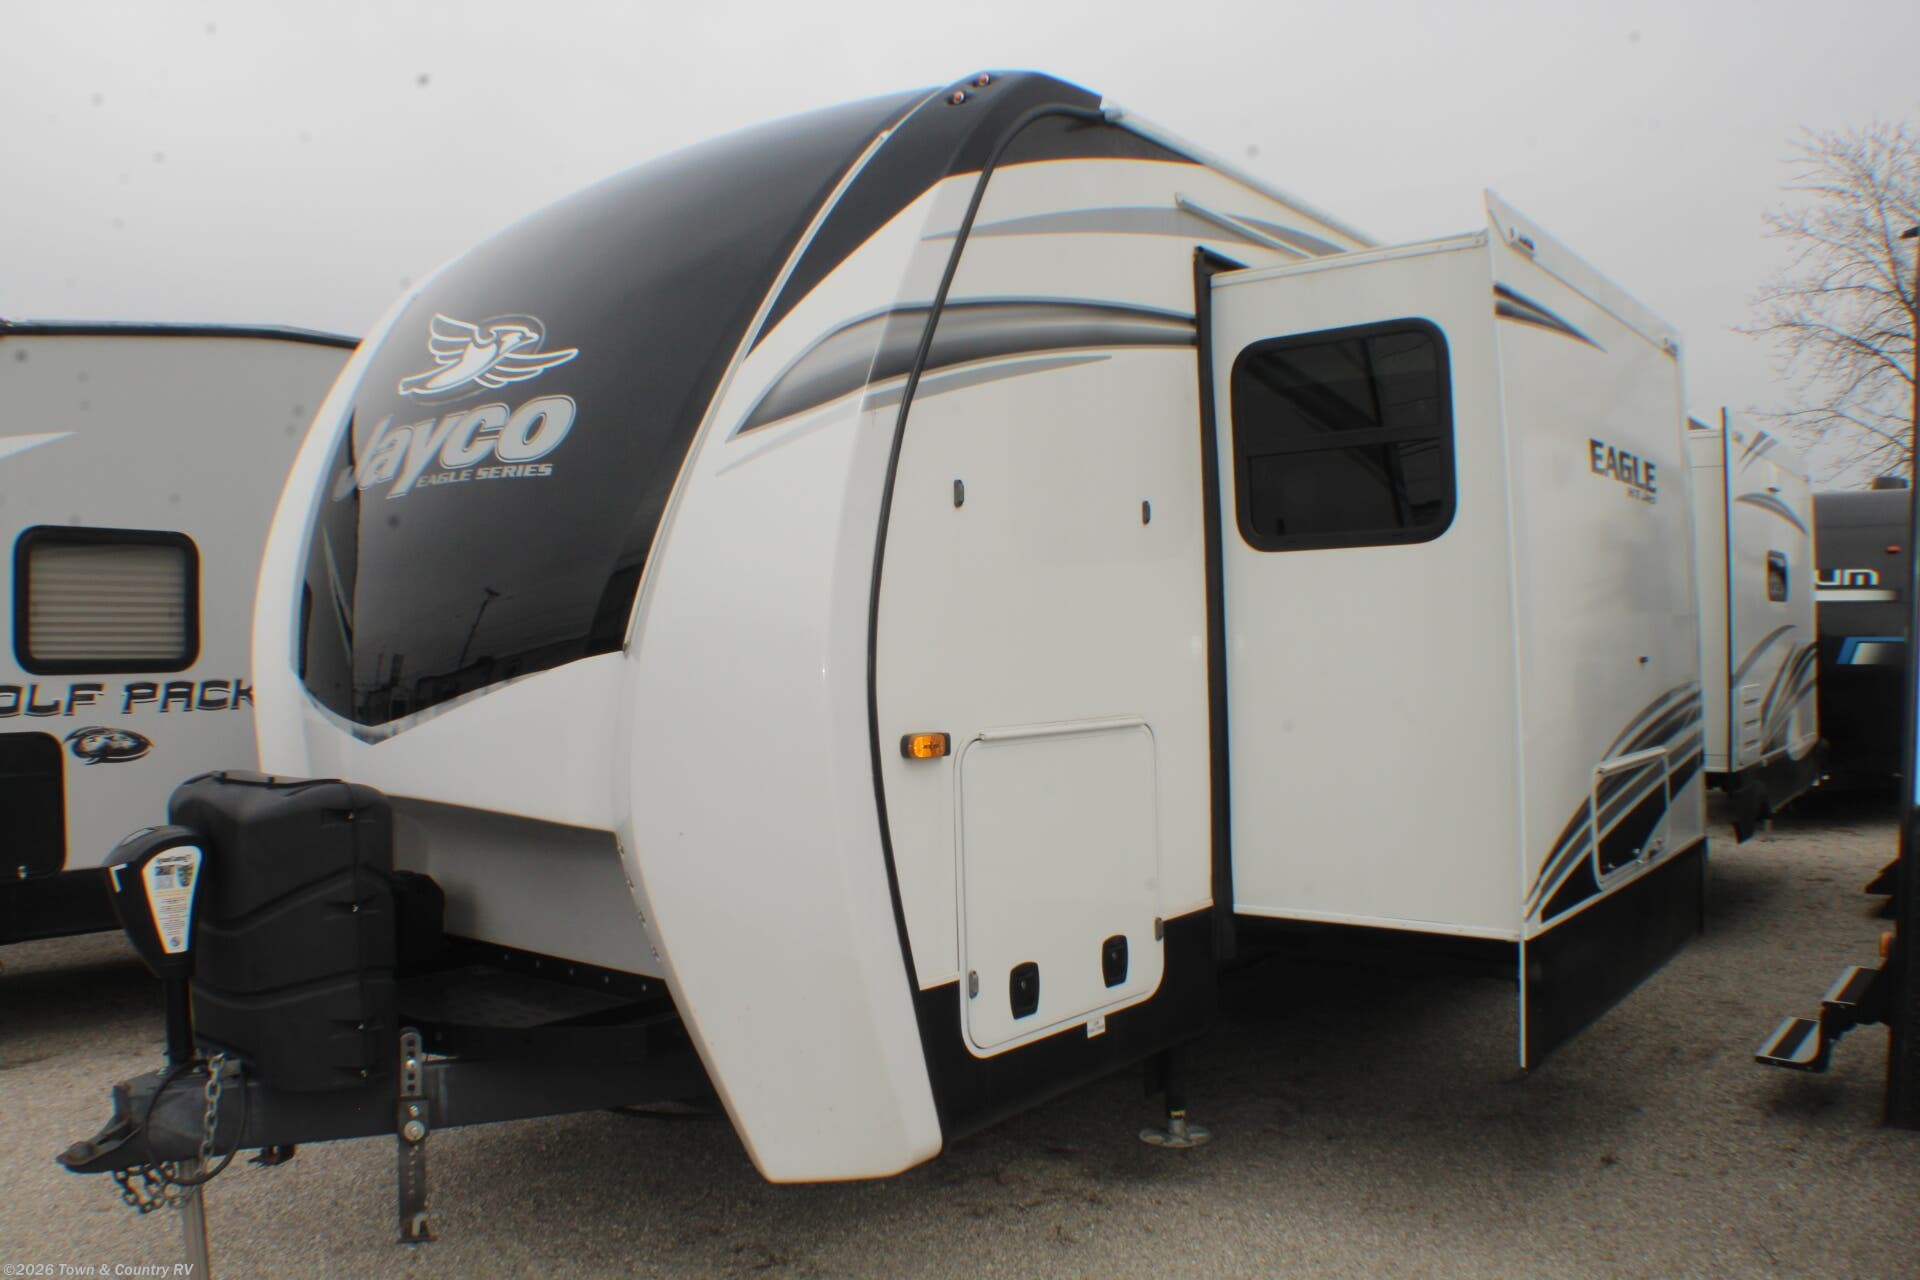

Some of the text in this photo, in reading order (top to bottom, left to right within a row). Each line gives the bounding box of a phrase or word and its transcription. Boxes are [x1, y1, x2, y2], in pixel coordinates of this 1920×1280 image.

[333, 395, 576, 500] Jayco
[1589, 438, 1656, 492] EAGLE
[415, 464, 553, 488] EAGLE SERIES
[121, 679, 254, 714] PACK
